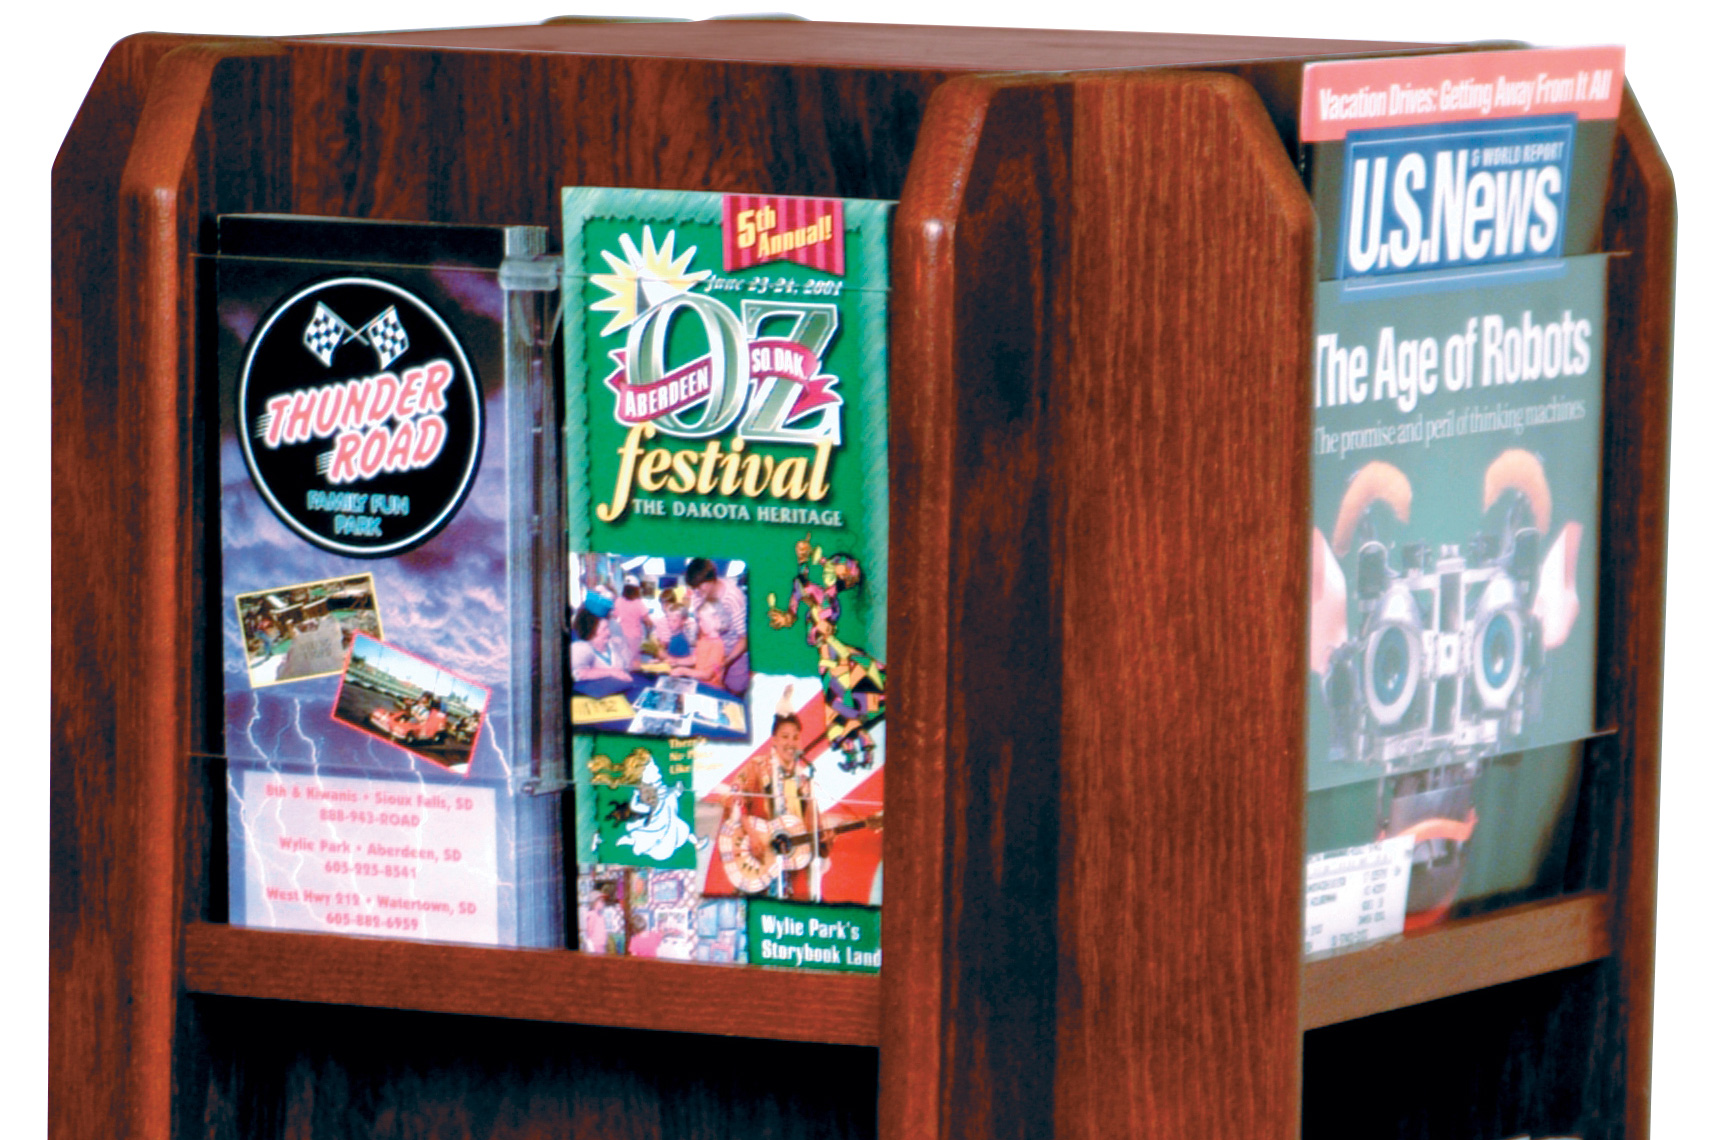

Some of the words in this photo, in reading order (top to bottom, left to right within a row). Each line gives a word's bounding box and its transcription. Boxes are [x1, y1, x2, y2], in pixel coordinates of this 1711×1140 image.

[1319, 86, 1387, 121] Vacation
[1388, 82, 1437, 116] Drives:
[1439, 78, 1494, 114] Getting
[1494, 75, 1534, 111] Away
[1536, 72, 1577, 105] From
[1576, 70, 1588, 102] It
[1589, 69, 1613, 101] All
[1482, 145, 1521, 167] WORLD
[1522, 141, 1565, 162] REPORT
[737, 204, 776, 249] 5th
[757, 214, 833, 260] Annual!
[704, 274, 745, 293] June
[803, 279, 844, 296] 2001
[626, 293, 842, 445] OZ
[1315, 332, 1369, 408] The
[1373, 326, 1439, 413] Age
[1444, 316, 1478, 391] of
[1481, 310, 1592, 387] Robots
[264, 359, 454, 449] THUNDER
[625, 365, 710, 418] ABERDEEN
[1340, 419, 1397, 460] promise
[1397, 413, 1424, 445] and
[1425, 409, 1454, 448] peril
[1455, 406, 1469, 435] of
[1469, 402, 1524, 435] thinking
[1525, 395, 1586, 426] machines
[327, 416, 447, 484] ROAD
[597, 420, 835, 523] festival
[306, 489, 369, 513] FAMILY
[370, 493, 410, 516] FUN
[632, 498, 666, 516] THE
[672, 501, 750, 521] DAKOTA
[756, 505, 844, 527] HERITAGE
[334, 514, 383, 538] PARK
[265, 783, 287, 798] 8th
[291, 785, 302, 799] &
[306, 786, 358, 802] Kiwanis
[374, 791, 412, 806] Sioux
[416, 794, 451, 812] Falls,
[455, 797, 474, 811] SD
[319, 808, 421, 828] 888-943-ROAD
[279, 836, 314, 854] Wylie
[320, 839, 350, 853] Park
[367, 842, 439, 863] Aberdeen,
[443, 848, 462, 862] SD
[266, 886, 299, 902] West
[303, 889, 331, 906] Hwy
[335, 891, 360, 906] 212
[377, 894, 454, 915] Watertown,
[458, 900, 477, 915] SD
[761, 914, 804, 940] Wylie
[808, 917, 860, 941] Park's
[761, 938, 841, 967] Storybook
[846, 946, 882, 968] Land
